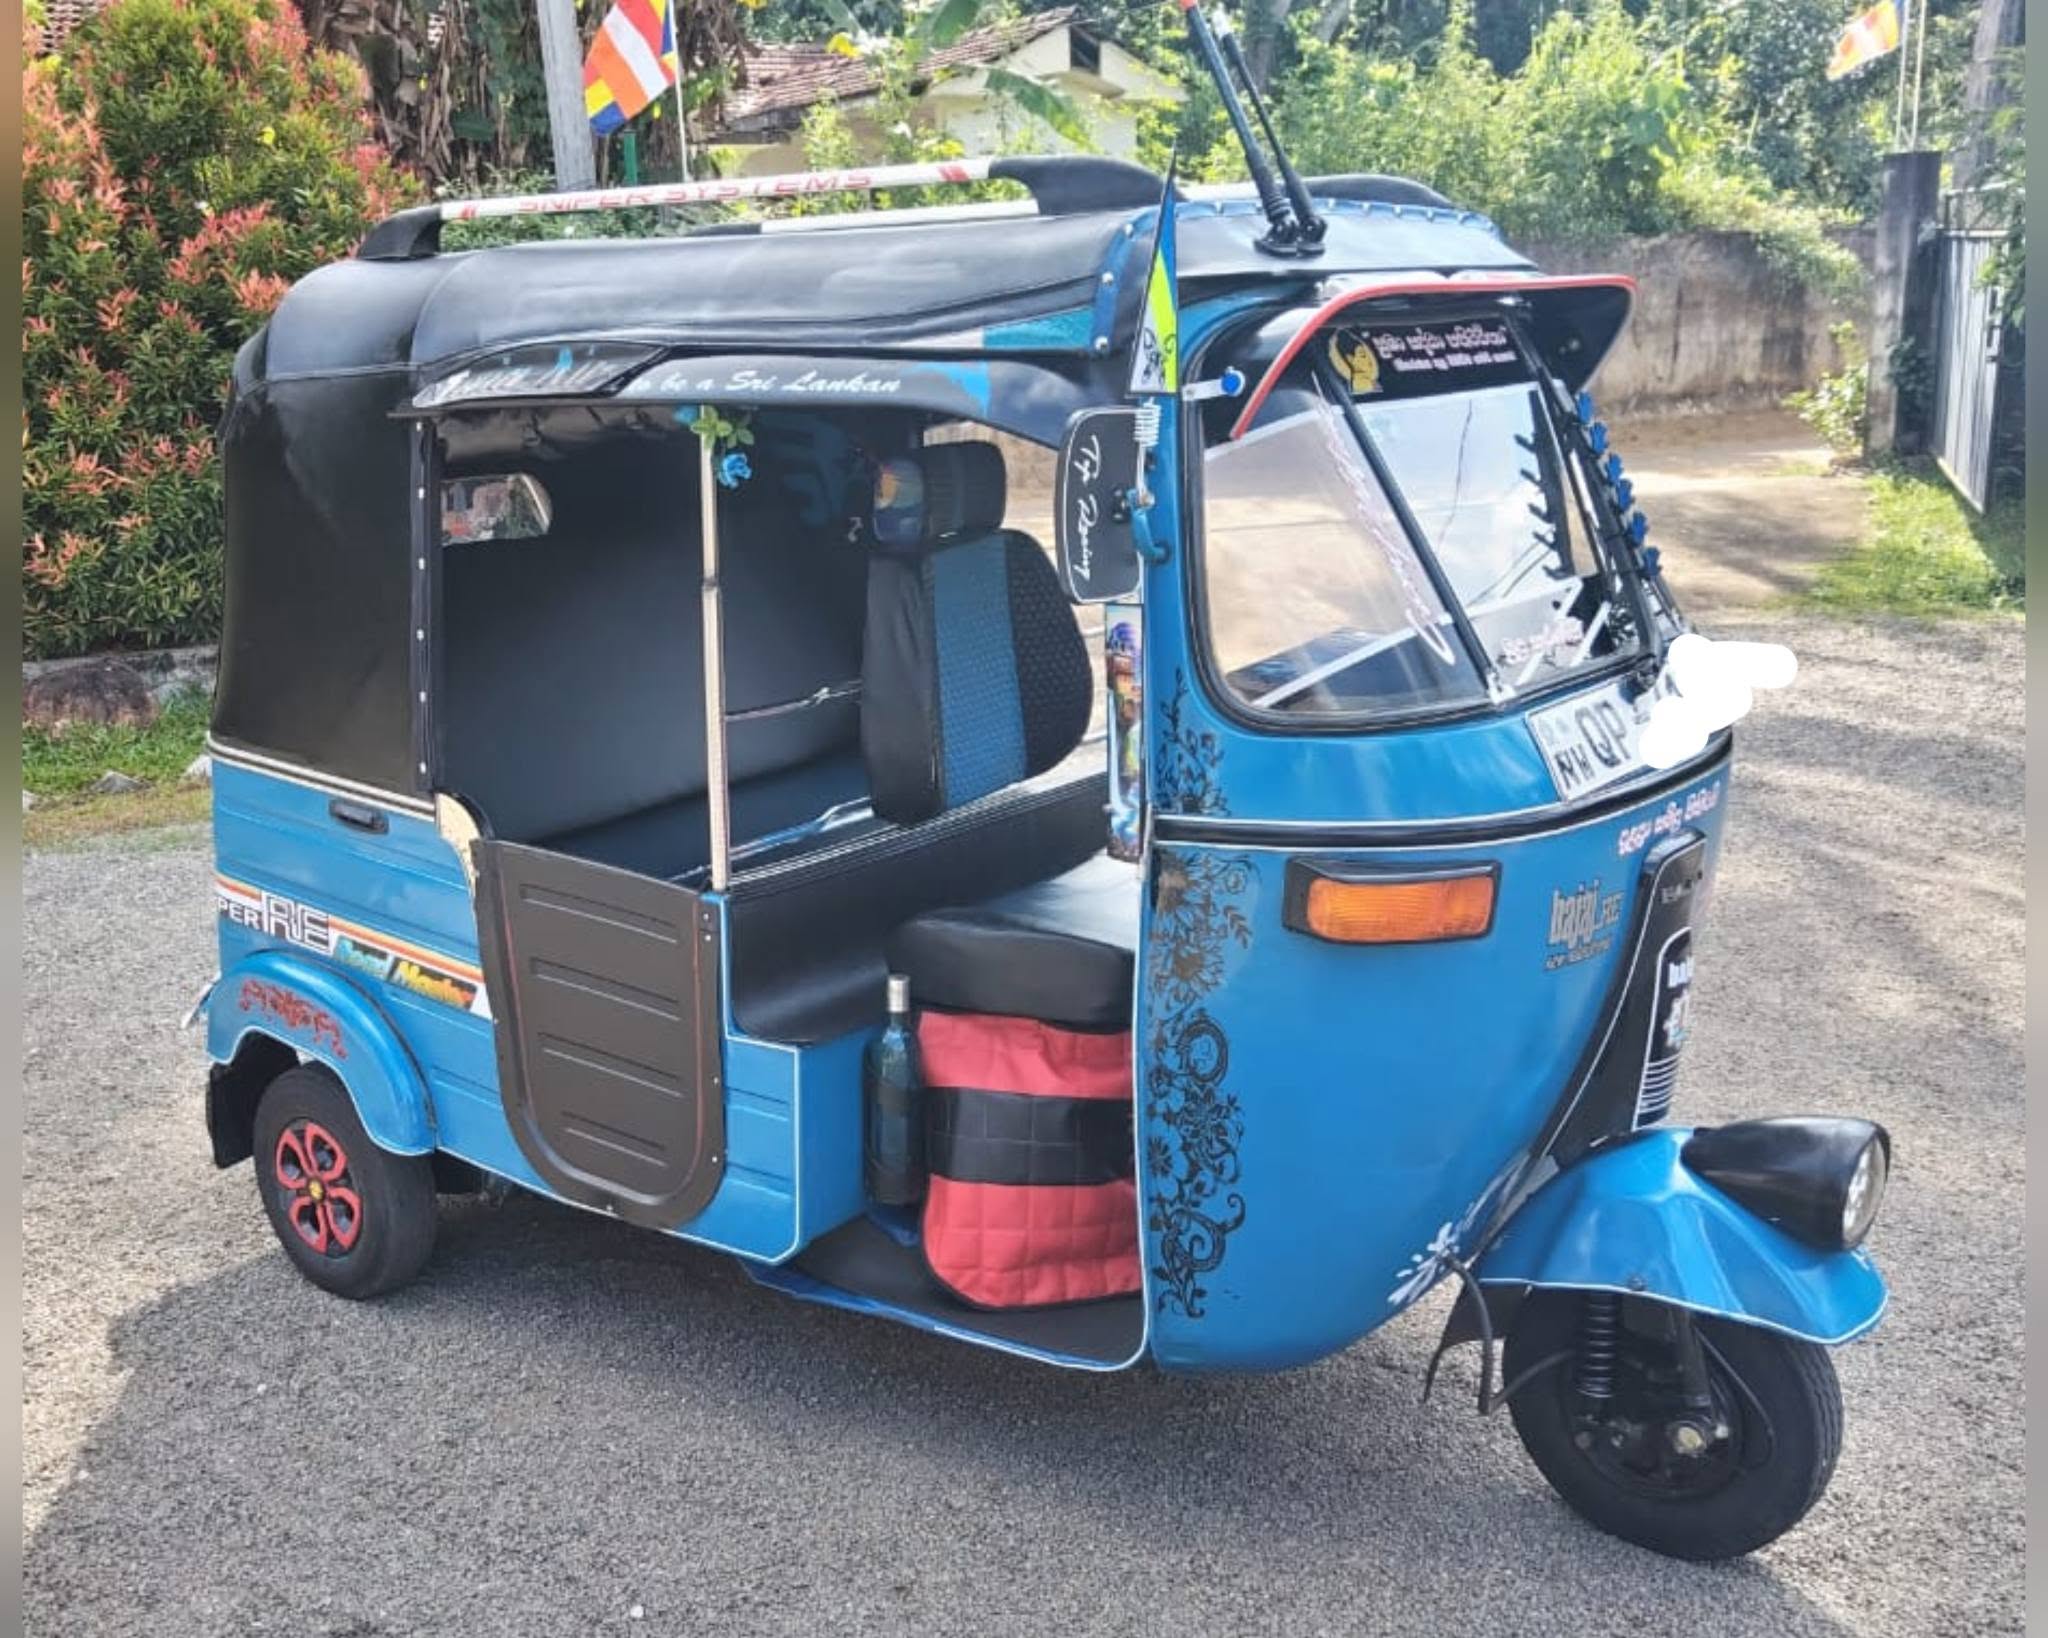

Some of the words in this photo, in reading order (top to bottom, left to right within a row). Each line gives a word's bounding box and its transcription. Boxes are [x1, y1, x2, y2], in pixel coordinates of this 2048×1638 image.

[660, 372, 688, 393] be
[695, 378, 713, 392] a
[725, 370, 777, 392] Sri
[781, 369, 901, 393] Lankan
[1574, 700, 1632, 769] QP
[262, 890, 333, 956] RE
